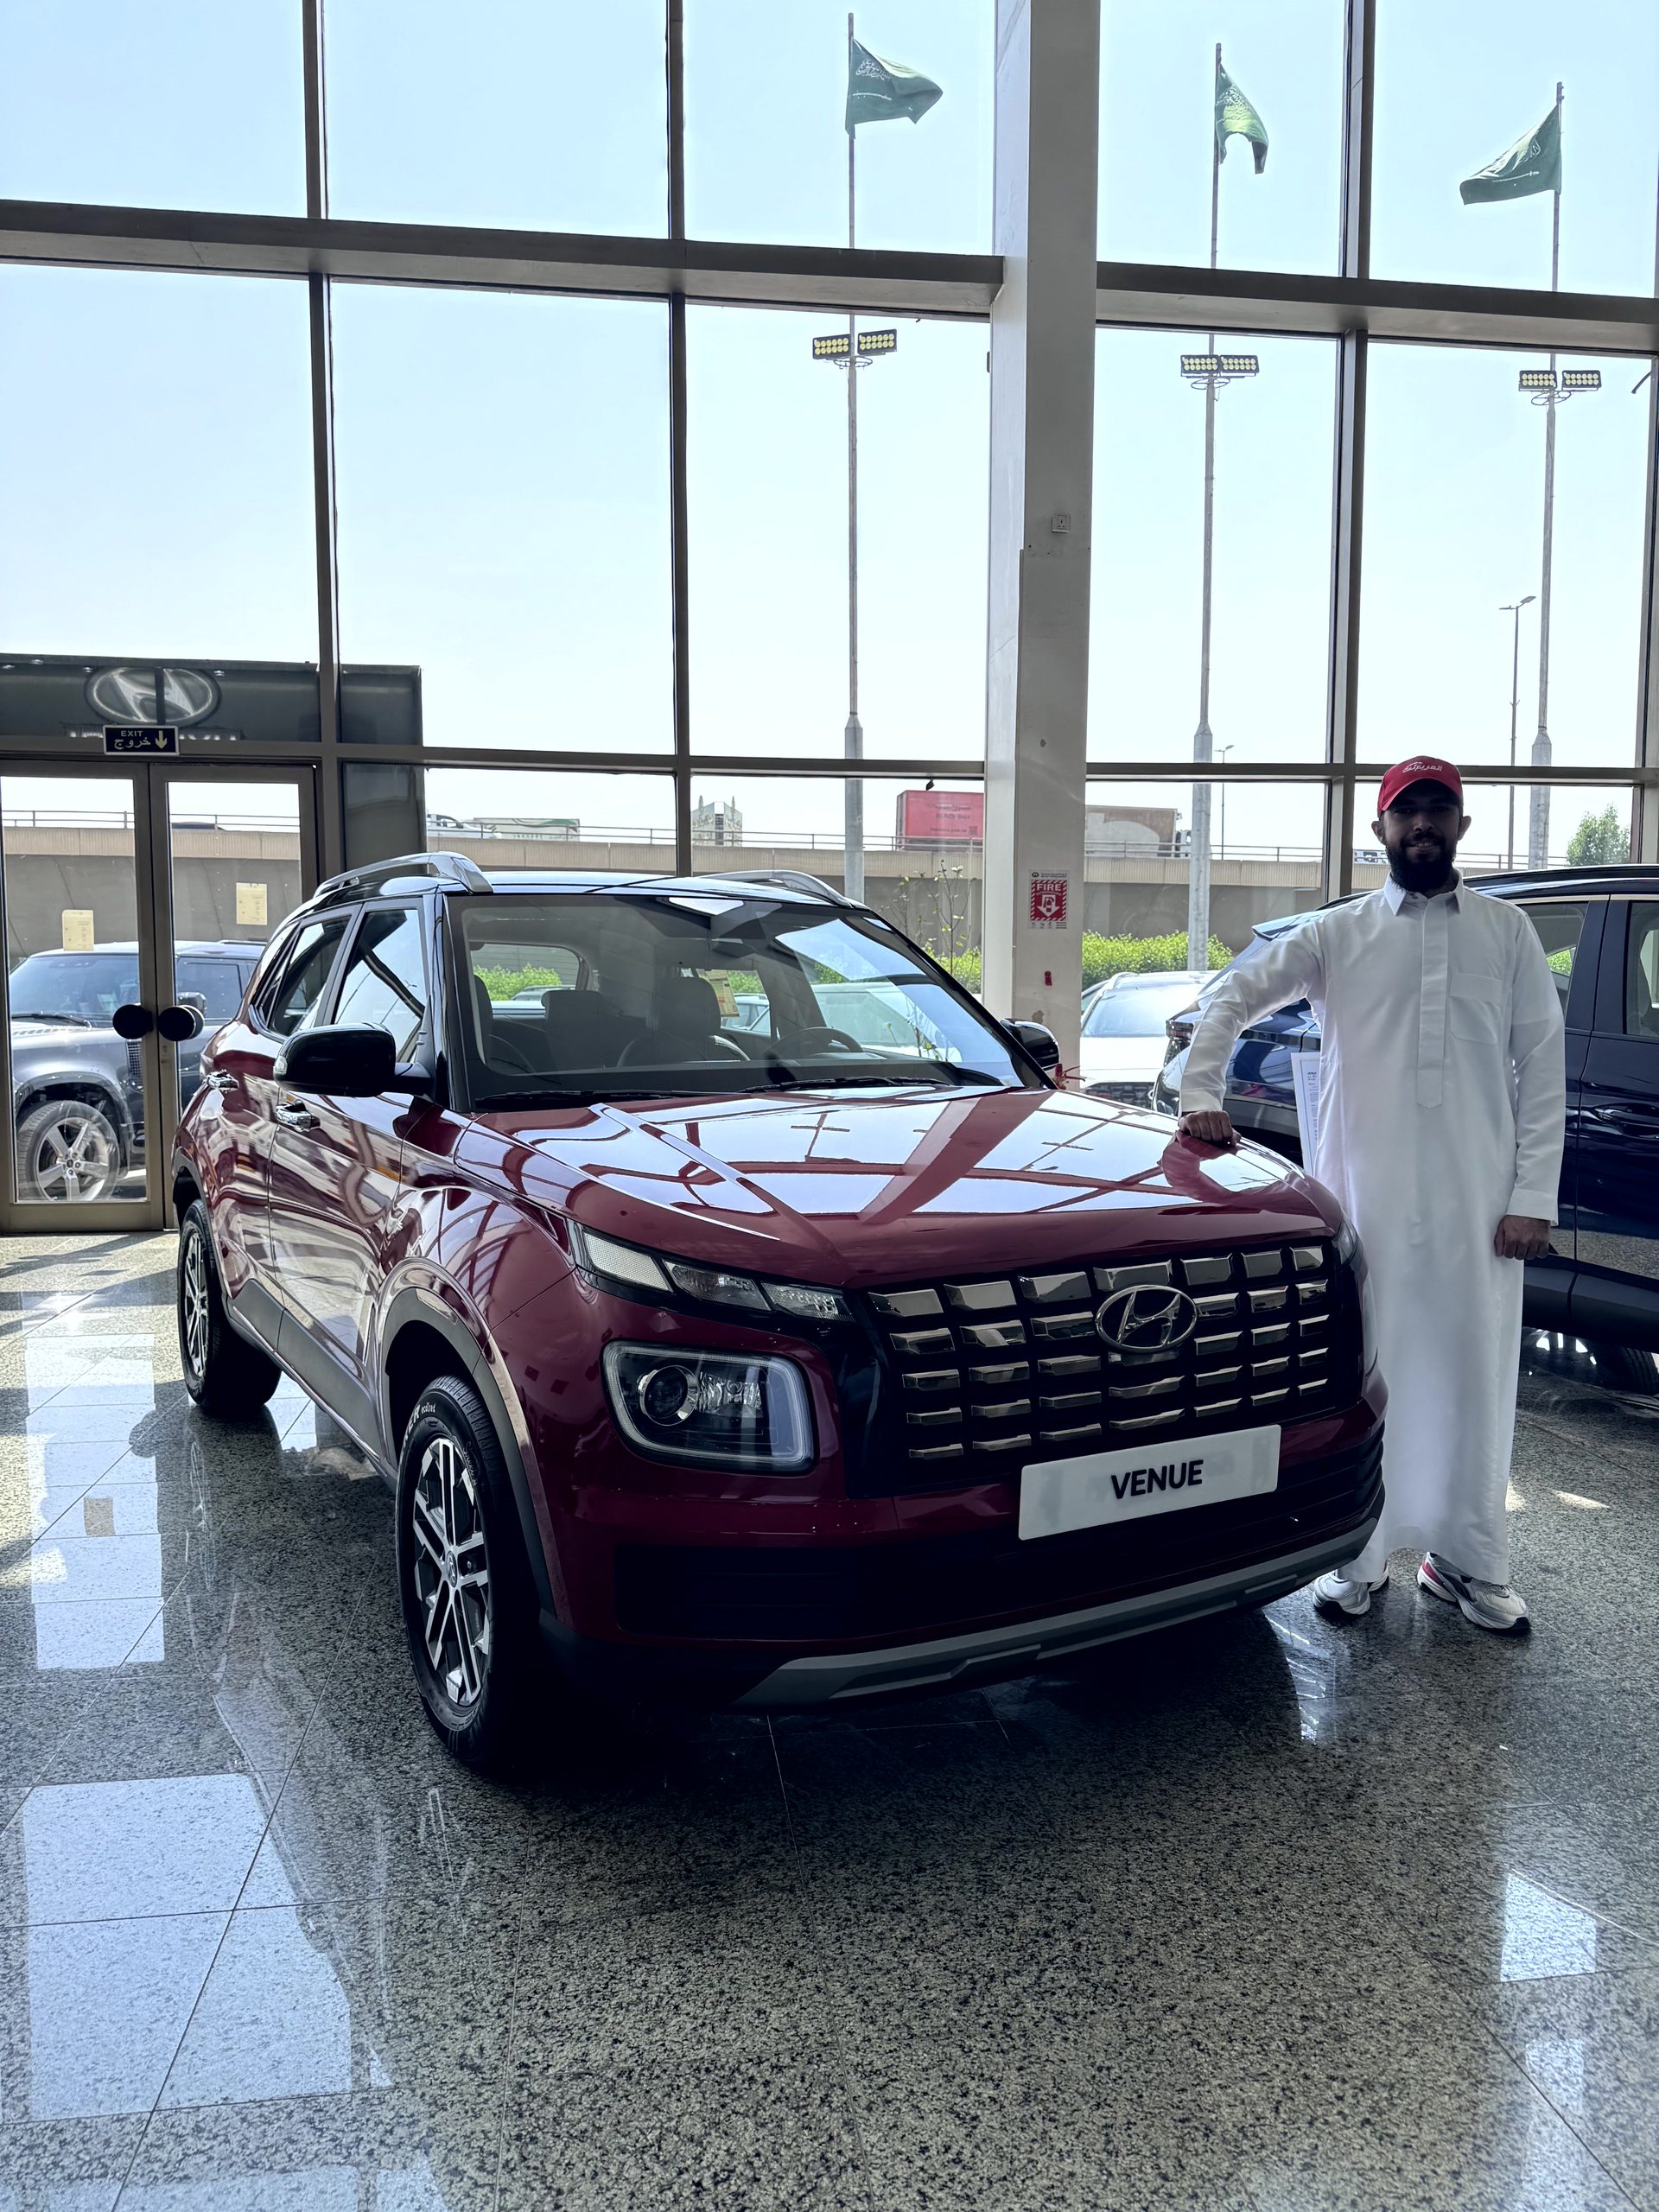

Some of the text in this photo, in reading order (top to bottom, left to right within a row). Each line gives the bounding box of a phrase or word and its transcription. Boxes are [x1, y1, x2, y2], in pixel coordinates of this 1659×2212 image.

[114, 737, 151, 750] خروج
[1036, 883, 1063, 892] FIRE
[1110, 1459, 1205, 1500] VENUE
